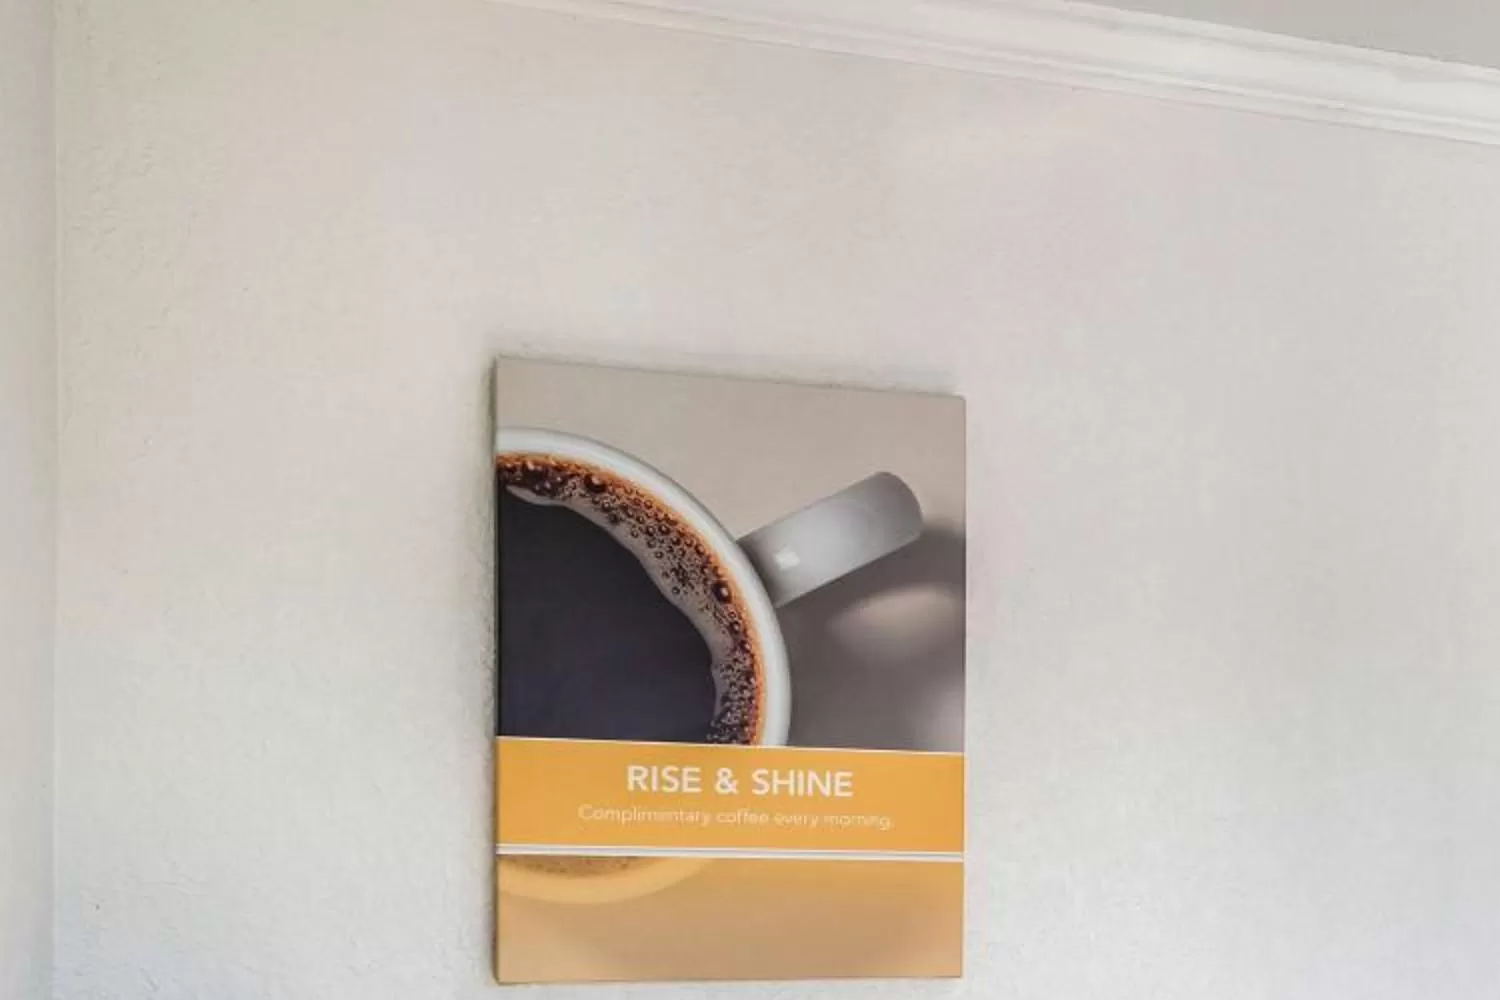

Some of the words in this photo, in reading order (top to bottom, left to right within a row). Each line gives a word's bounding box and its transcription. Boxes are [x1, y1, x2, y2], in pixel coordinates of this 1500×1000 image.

[626, 765, 701, 793] RISE
[715, 768, 738, 795] &
[751, 769, 854, 797] SHINE
[577, 804, 711, 827] Complimentary
[716, 807, 769, 825] coffee
[774, 812, 819, 829] every
